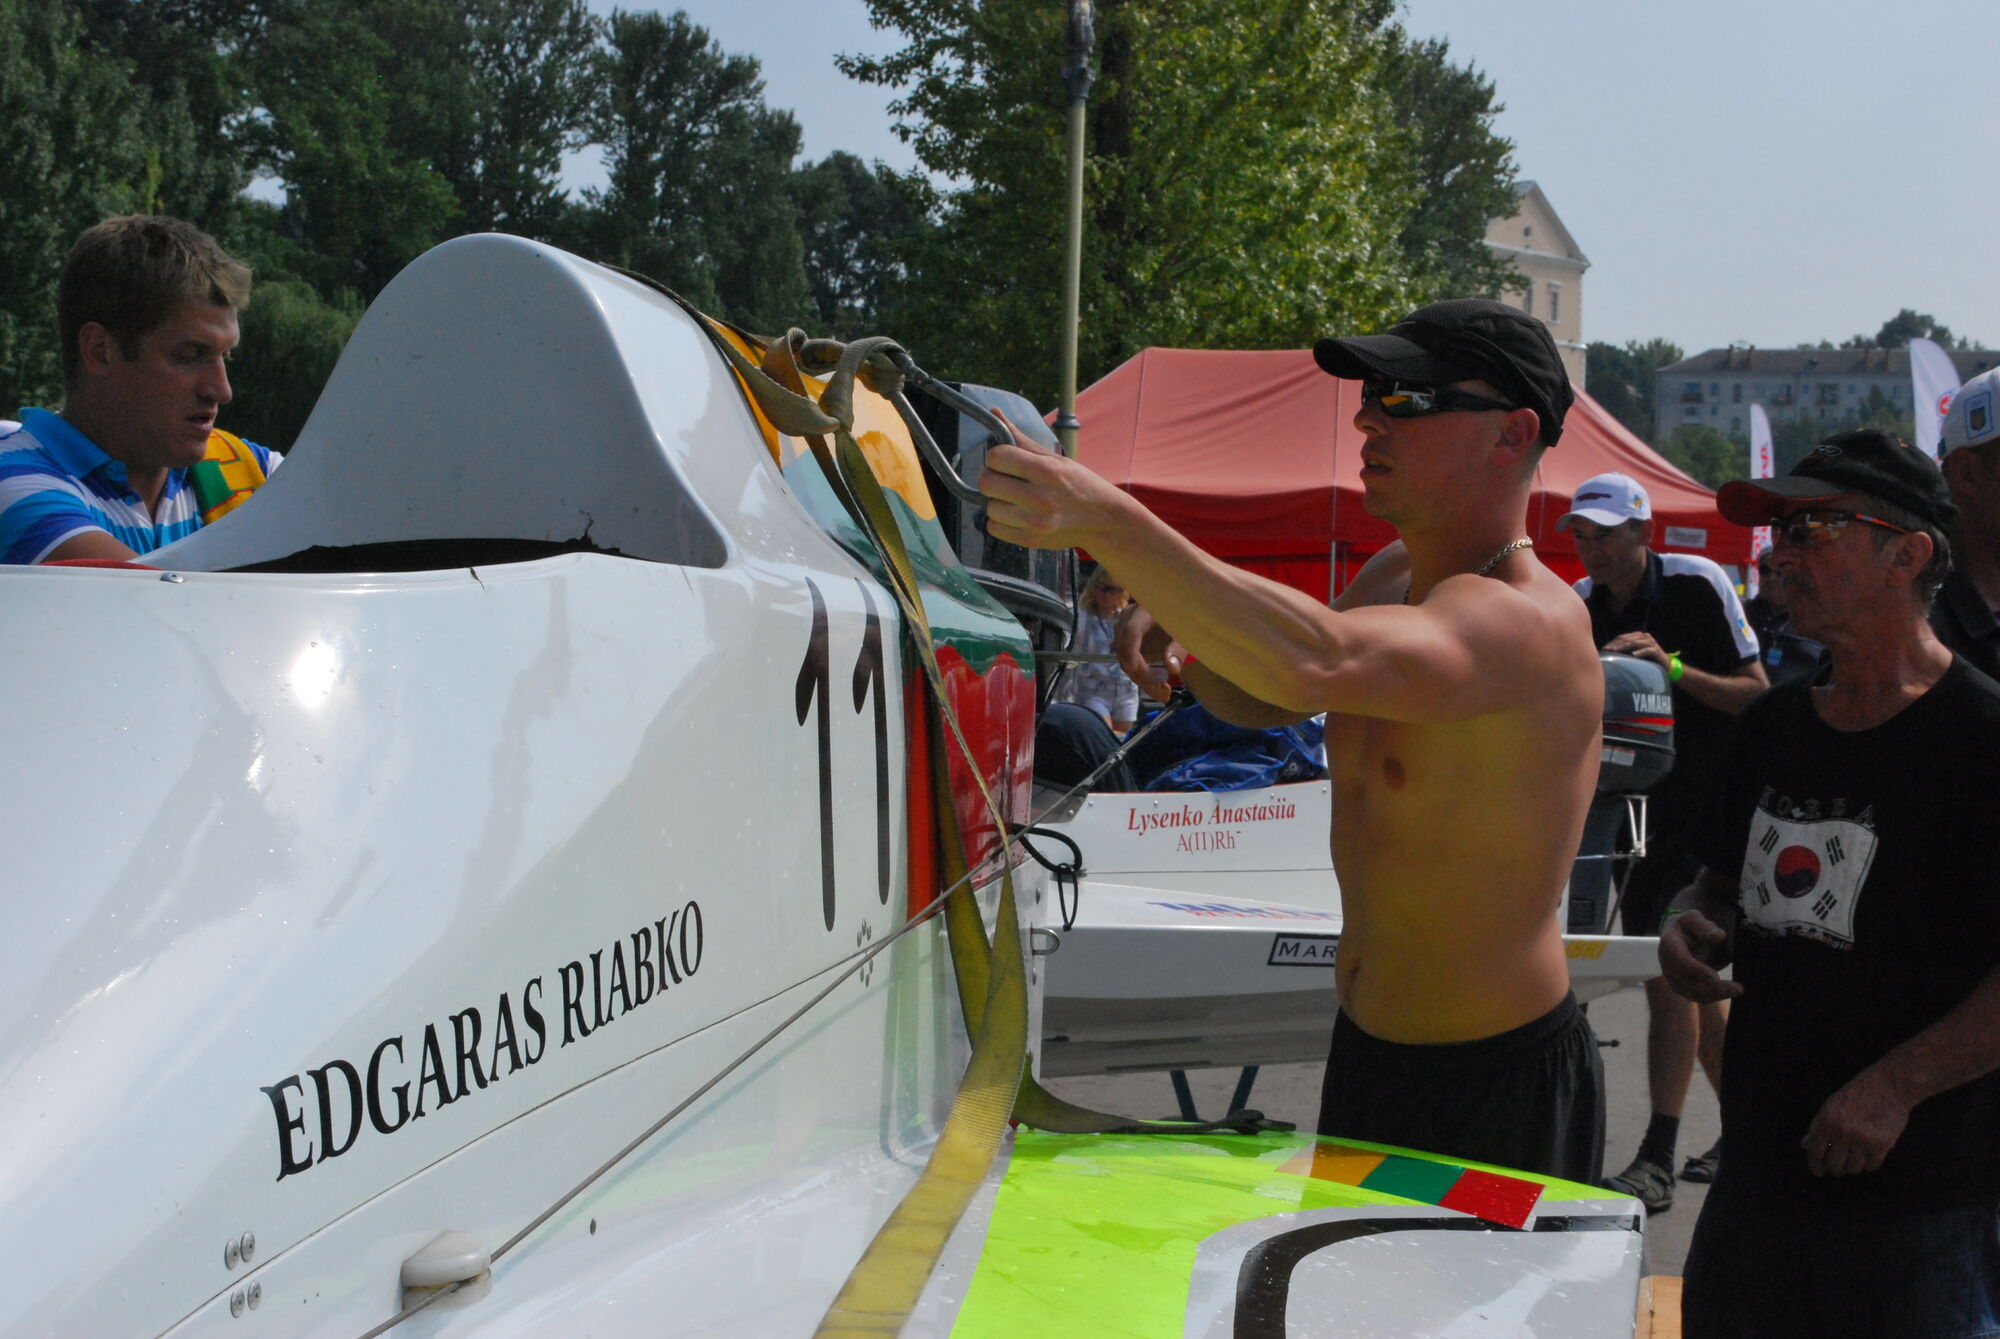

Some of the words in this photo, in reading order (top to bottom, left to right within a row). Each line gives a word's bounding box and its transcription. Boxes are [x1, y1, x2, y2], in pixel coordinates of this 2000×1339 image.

[1632, 692, 1672, 715] YAMAHA
[795, 576, 890, 932] 11
[1127, 804, 1203, 836] Lysenko
[1207, 798, 1296, 825] Anastasiia
[1278, 941, 1337, 958] MAR
[260, 975, 546, 1183] EDGARAS
[559, 900, 704, 1049] RIABKO
